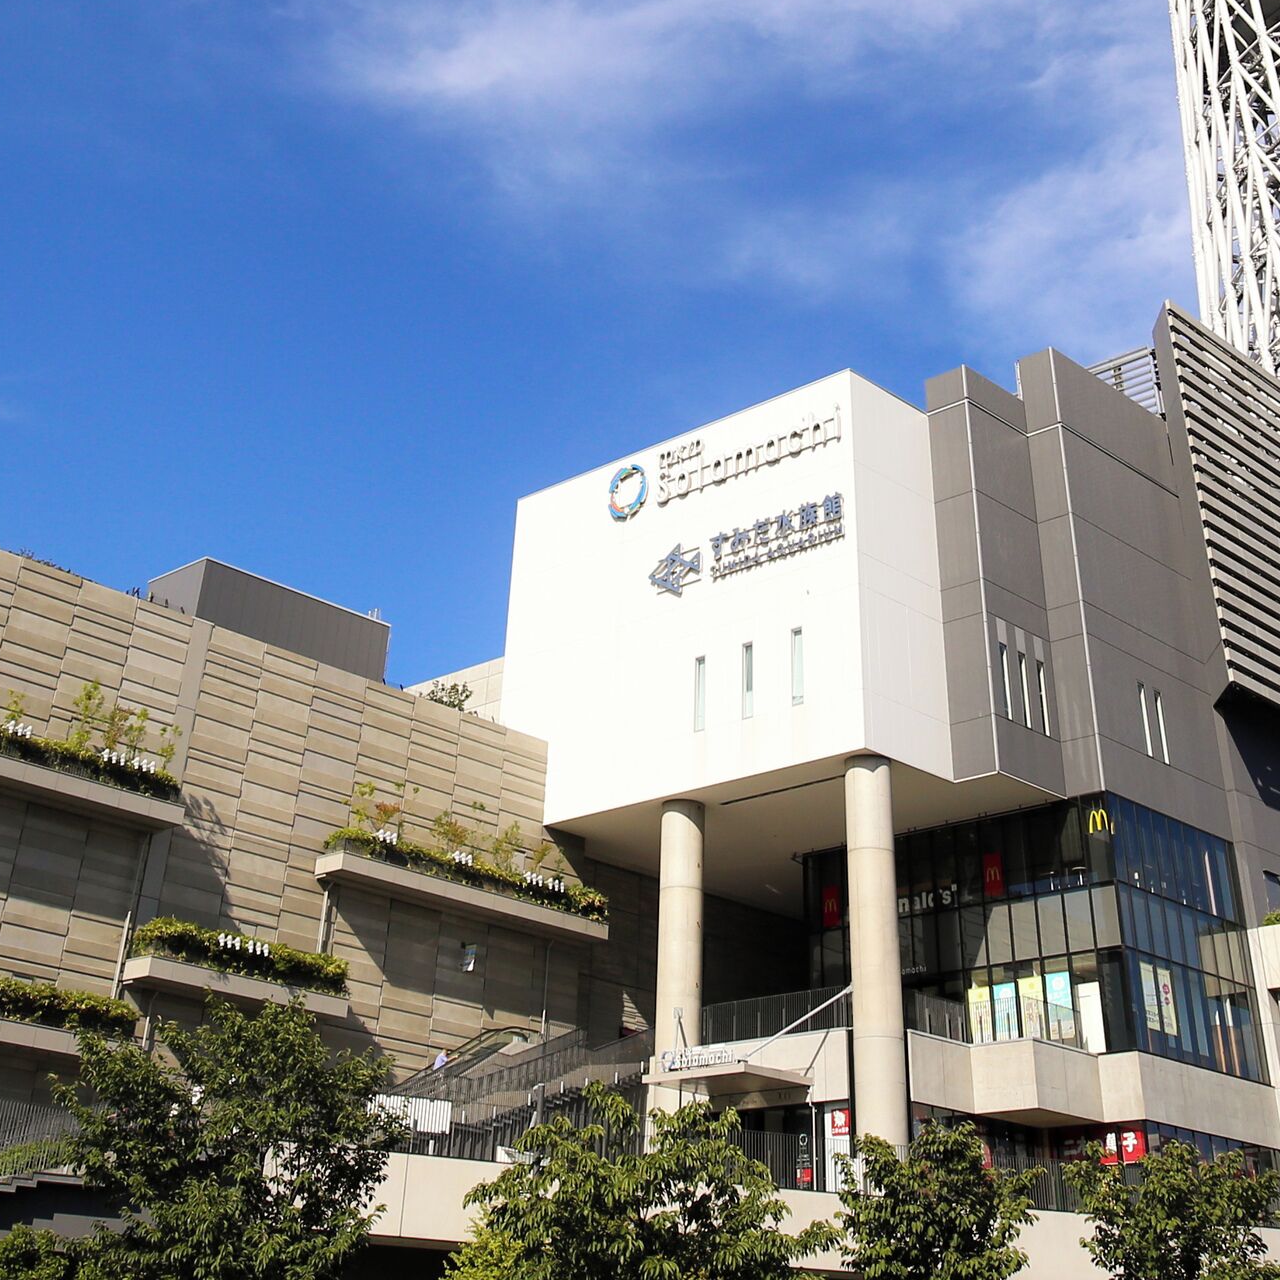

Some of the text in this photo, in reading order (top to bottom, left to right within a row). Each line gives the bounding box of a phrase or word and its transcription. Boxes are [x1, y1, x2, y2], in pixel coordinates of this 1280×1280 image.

[656, 403, 842, 507] Solamachi
[659, 439, 704, 469] TOKYO
[710, 491, 844, 560] すみだ水族館
[711, 523, 845, 582] SUMIDA AQUARIUM
